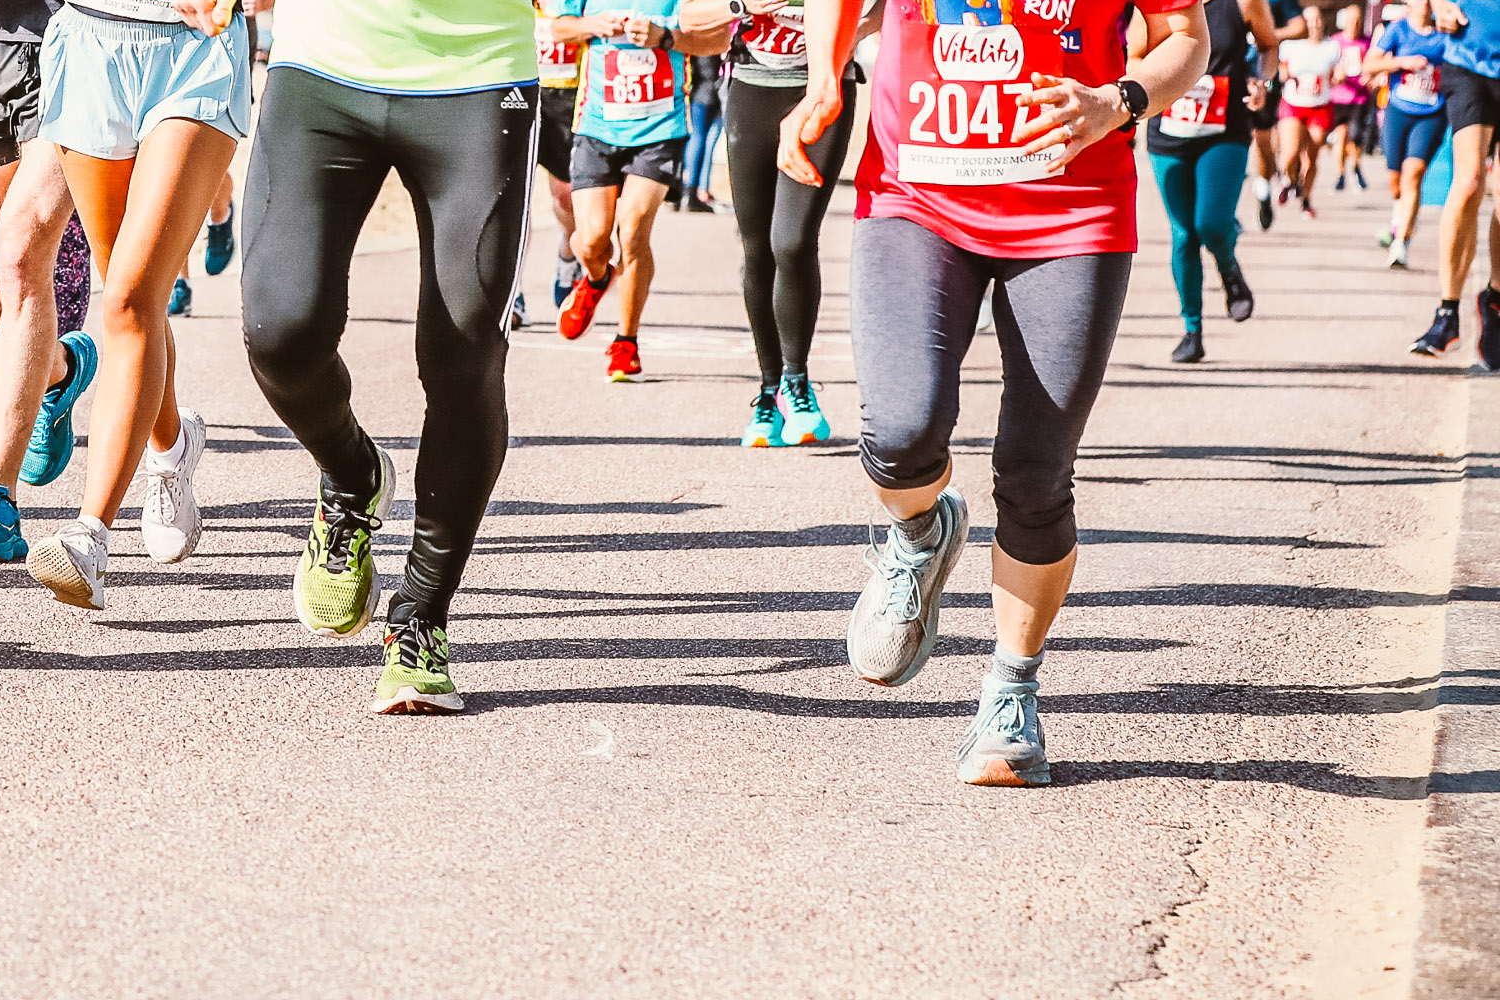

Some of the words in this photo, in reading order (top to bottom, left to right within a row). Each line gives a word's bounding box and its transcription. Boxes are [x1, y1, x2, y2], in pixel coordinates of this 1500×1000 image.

[120, 2, 140, 12] RUN
[939, 32, 1019, 73] Vitality
[612, 74, 655, 103] 651
[500, 100, 529, 110] adidas
[908, 80, 1034, 145] 2047
[909, 153, 960, 166] VITALITY
[961, 153, 1052, 166] BOURNEMOUTH
[955, 168, 977, 178] BAY
[980, 168, 1004, 178] RUN
